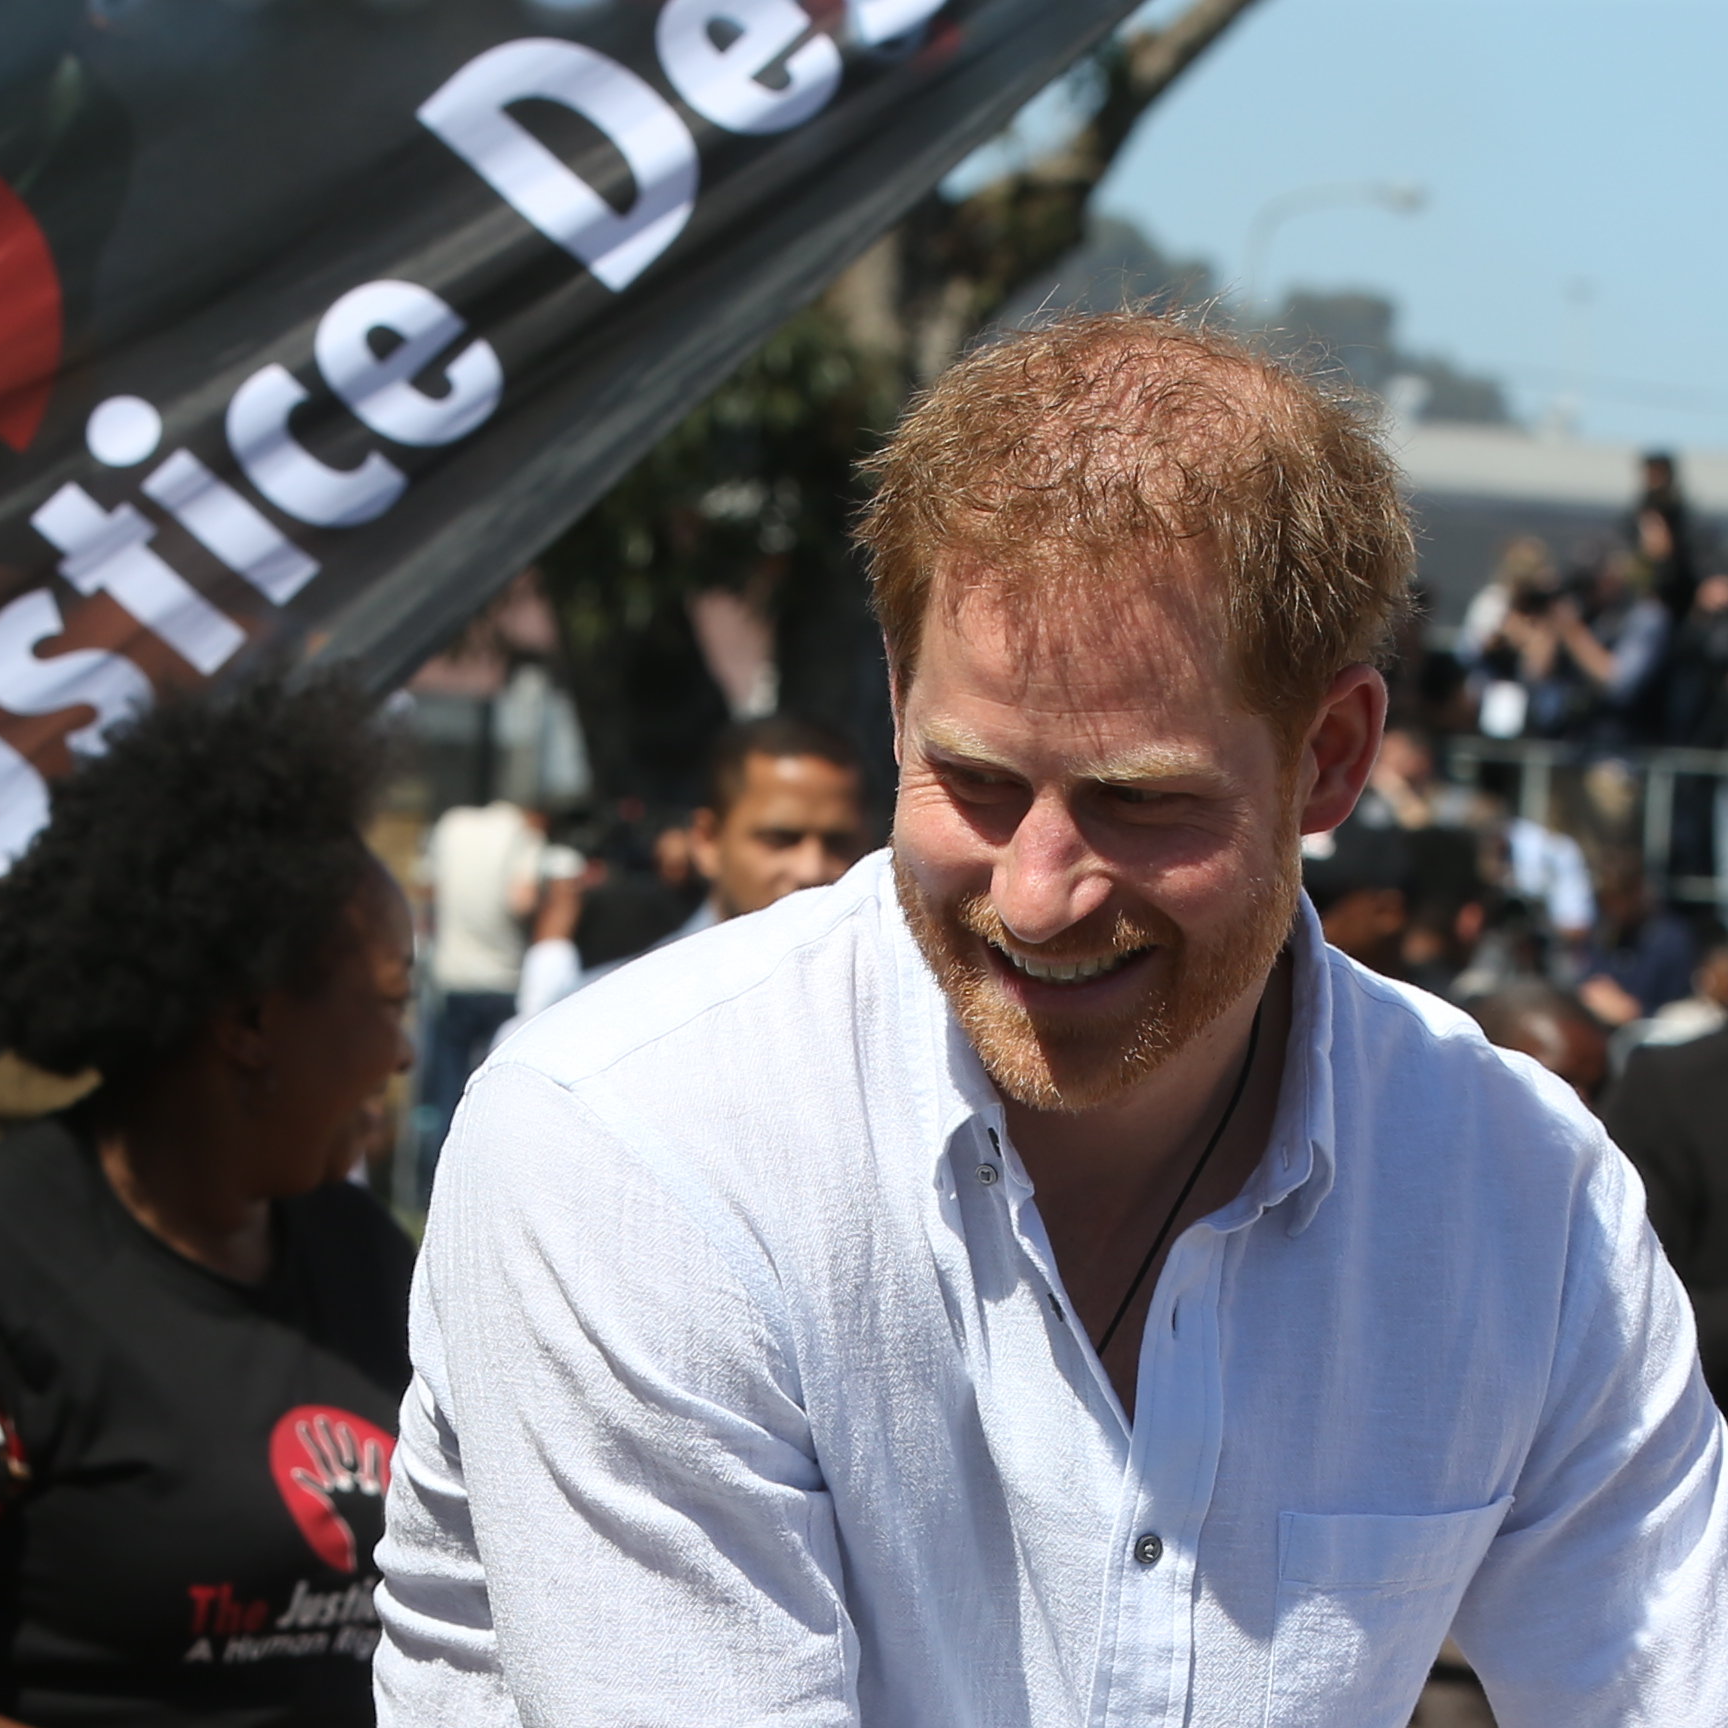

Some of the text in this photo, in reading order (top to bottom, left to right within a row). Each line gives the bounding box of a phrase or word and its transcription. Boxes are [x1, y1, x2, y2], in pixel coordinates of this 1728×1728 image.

[416, 0, 948, 293] De
[188, 1577, 379, 1637] The Justi
